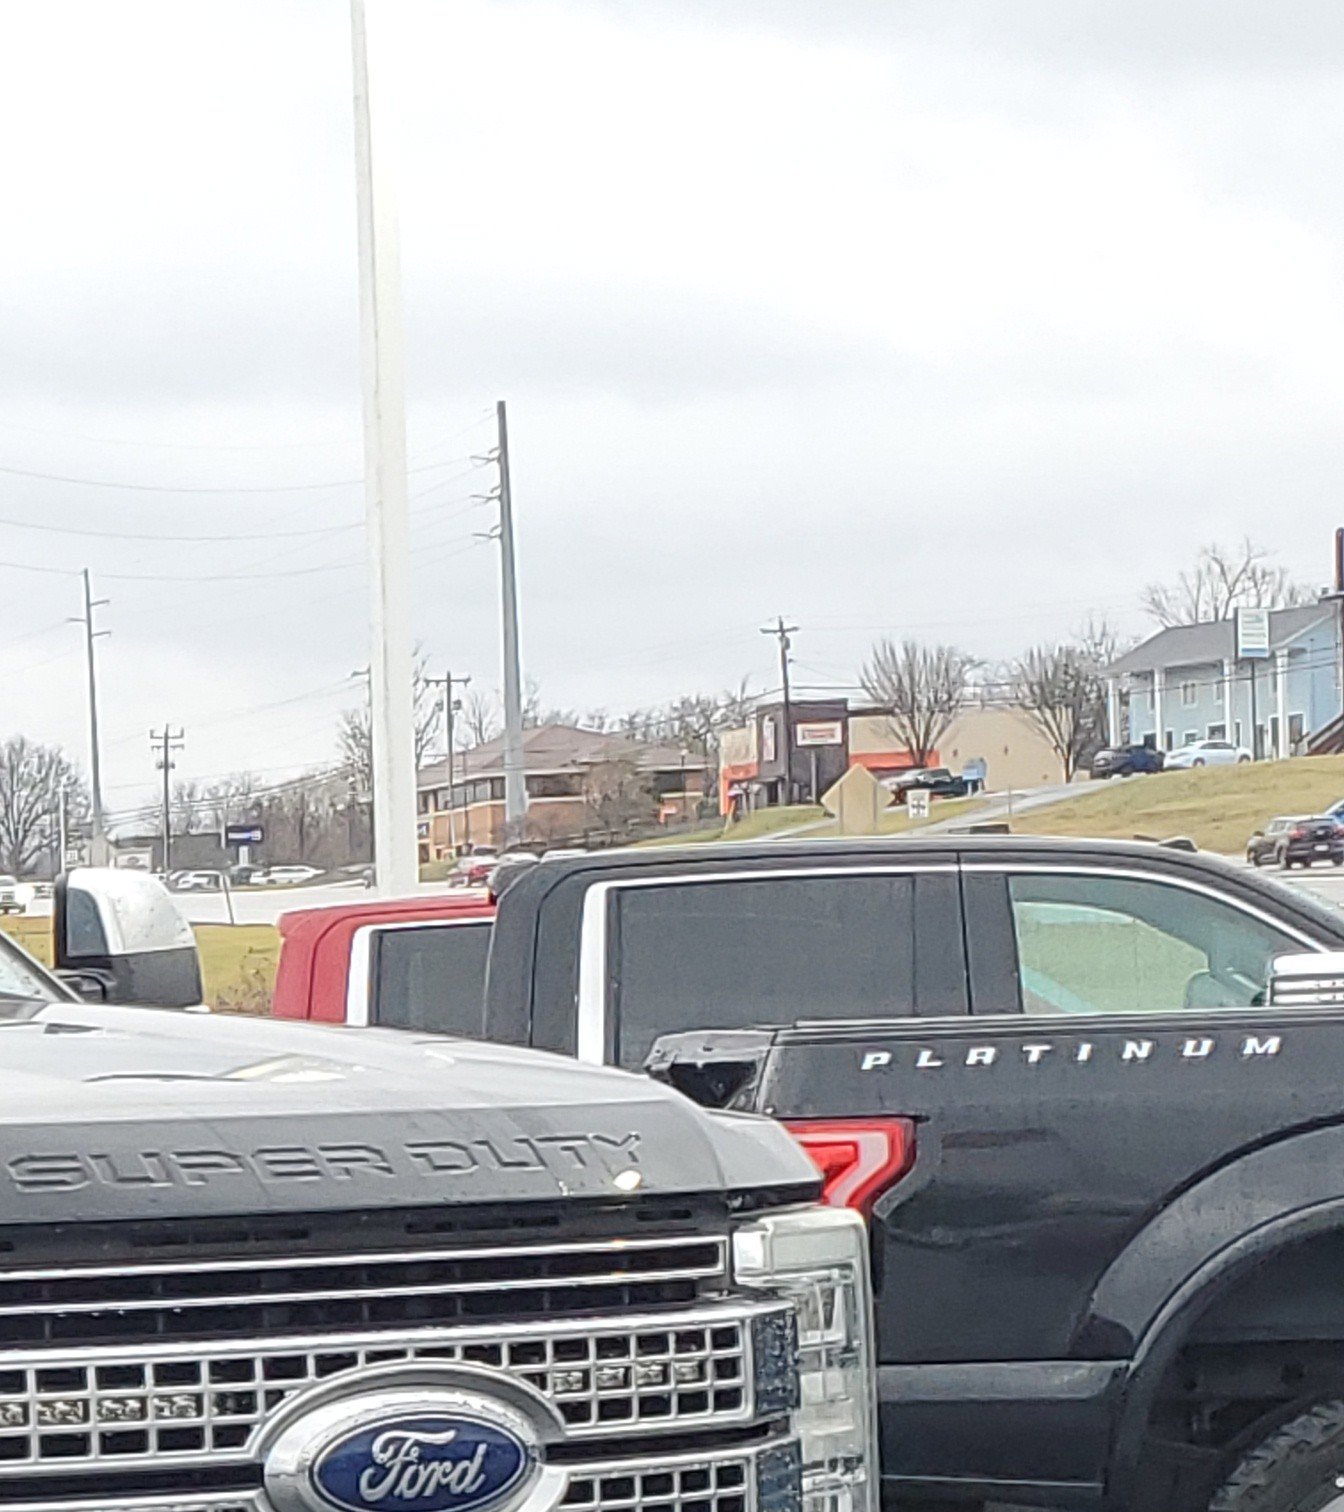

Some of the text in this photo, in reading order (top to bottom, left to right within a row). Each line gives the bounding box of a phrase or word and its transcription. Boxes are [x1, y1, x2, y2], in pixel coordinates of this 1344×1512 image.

[860, 1036, 1282, 1072] PLATINUM
[8, 1131, 641, 1195] SUPER DUTY
[359, 1429, 488, 1502] Ford
